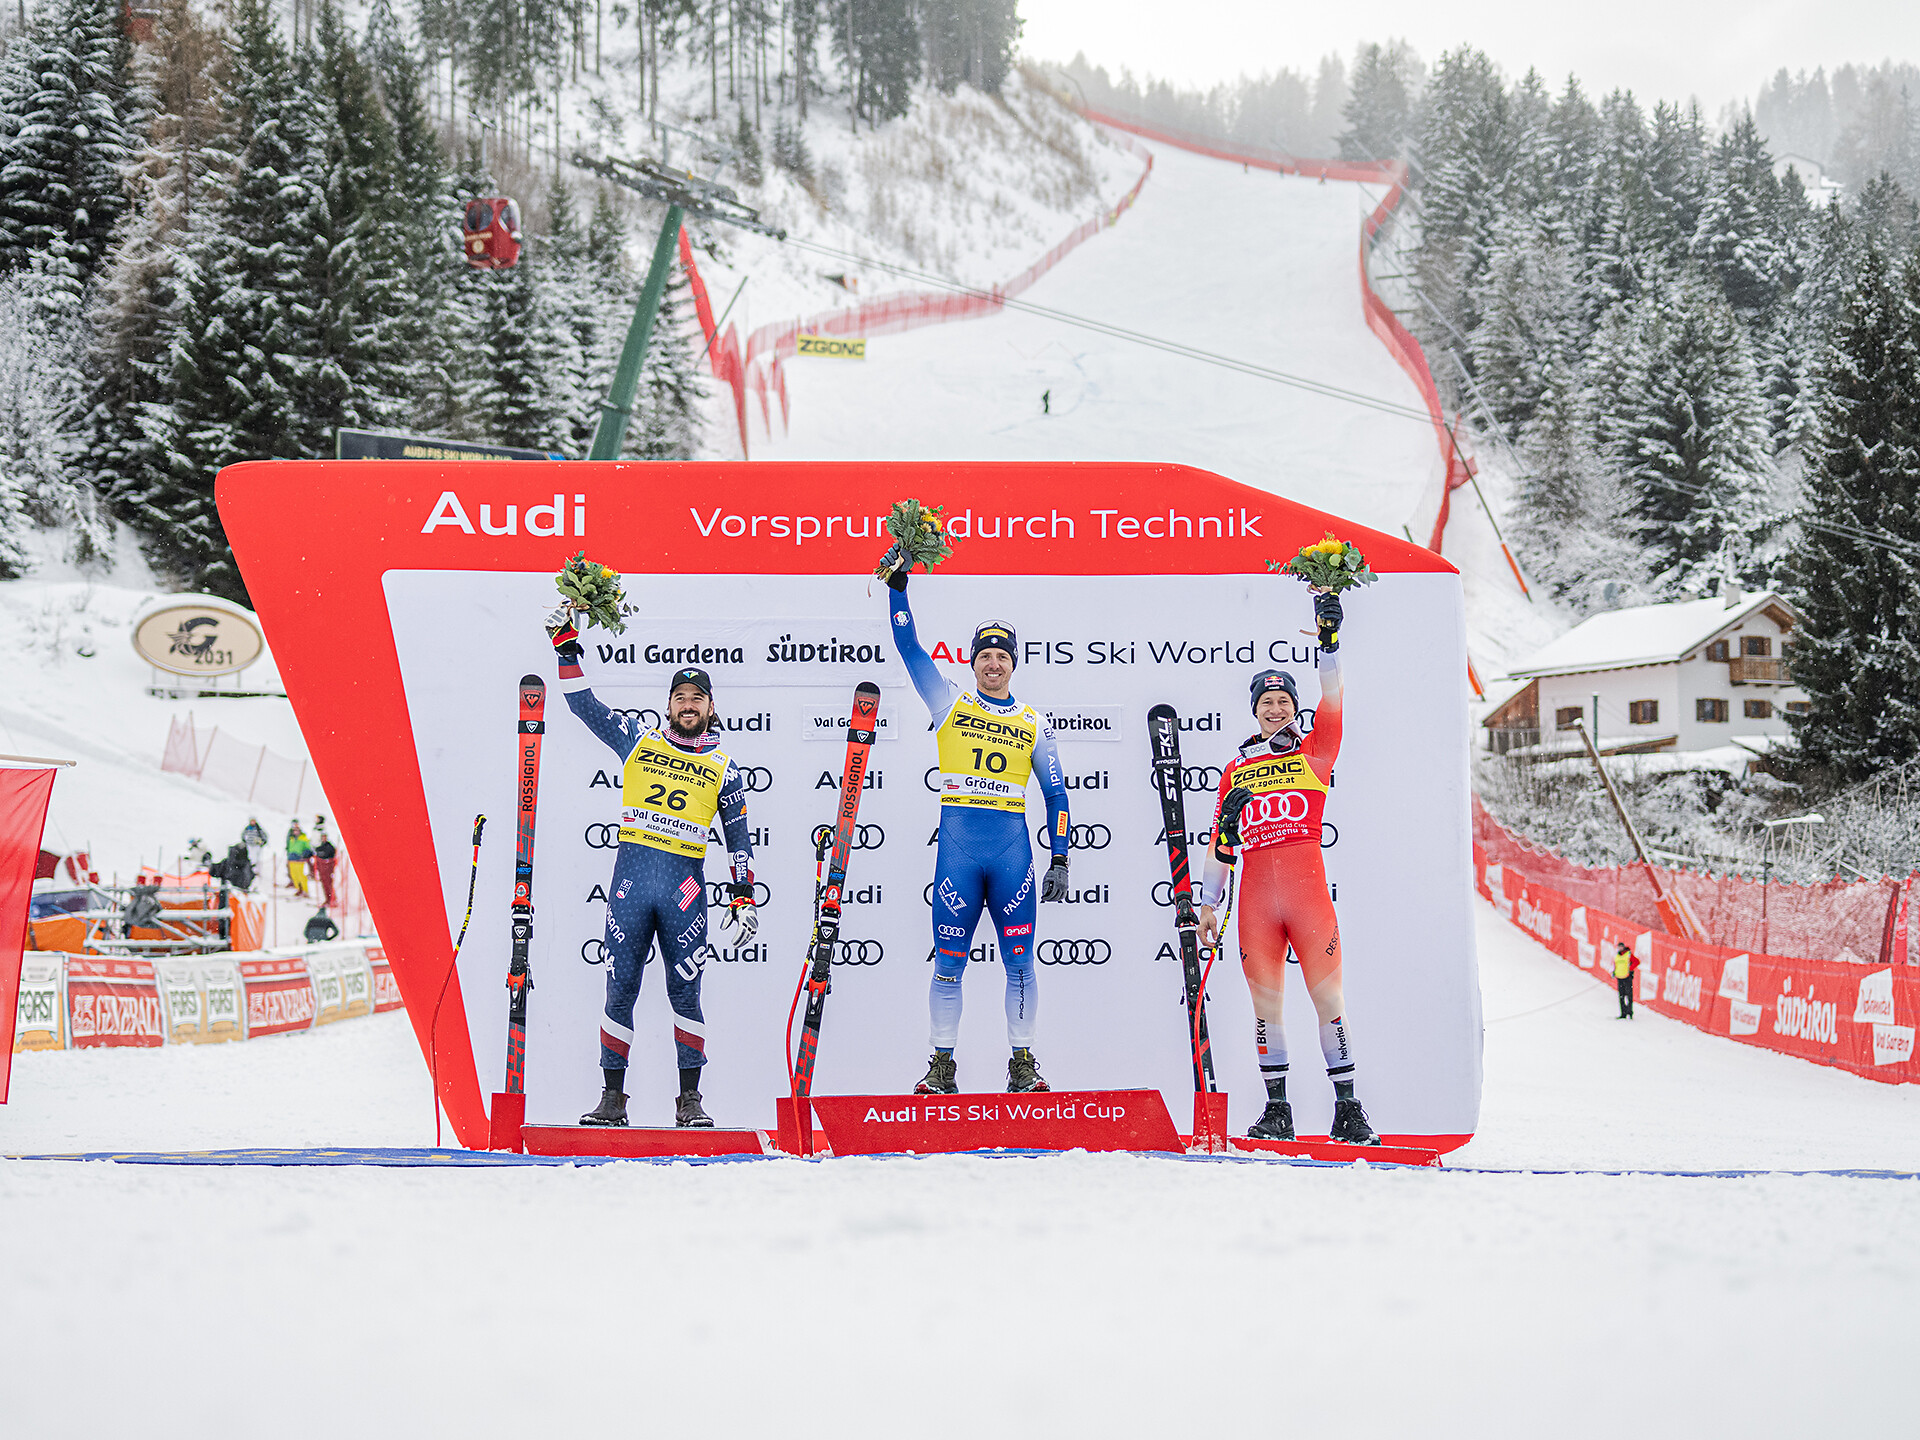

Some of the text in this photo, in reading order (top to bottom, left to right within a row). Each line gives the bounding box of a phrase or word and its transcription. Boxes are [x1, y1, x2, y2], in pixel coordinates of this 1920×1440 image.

[800, 339, 865, 356] ZGONC
[403, 445, 425, 458] AUDI
[428, 448, 442, 460] FIS
[420, 491, 586, 537] Audi
[690, 507, 1263, 545] Vorsprun durch Technik
[195, 651, 233, 664] 2031
[597, 643, 744, 664] Val Gardena
[931, 641, 972, 664] Au
[1025, 641, 1074, 664] FIS
[1088, 640, 1135, 664] Ski
[1148, 640, 1254, 664] World
[814, 717, 834, 728] Val
[954, 713, 1033, 744] ZGONC
[1178, 713, 1222, 731] udi
[961, 730, 1025, 751] www.zgonc.at
[637, 749, 718, 783] ZGONC
[971, 748, 1008, 774] 10
[1047, 754, 1062, 787] Audi
[522, 742, 536, 812] ROSSIGNOL
[589, 769, 623, 789] Au
[642, 766, 706, 789] www.zgonc.at
[843, 749, 864, 819] ROSSIGNOL
[964, 776, 1010, 793] Gröden
[1063, 770, 1109, 790] udi
[1233, 761, 1303, 787] ZGONC
[1242, 776, 1295, 790] ww.zgonc.at
[644, 783, 689, 812] 26
[968, 798, 998, 806] ZGONC
[632, 808, 699, 834] Val Gardena
[642, 833, 672, 846] ZGONC
[680, 842, 704, 853] ZGONC
[707, 827, 771, 847] Adi
[1260, 827, 1299, 841] Gardena
[940, 876, 968, 911] EA7
[1006, 924, 1030, 936] enel
[1155, 942, 1224, 961] Adi
[19, 989, 55, 1024] FORST
[1256, 1016, 1267, 1045] BKW
[1335, 1026, 1349, 1061] helvetia
[863, 1103, 1126, 1123] Audi FIS Ski World Cup
